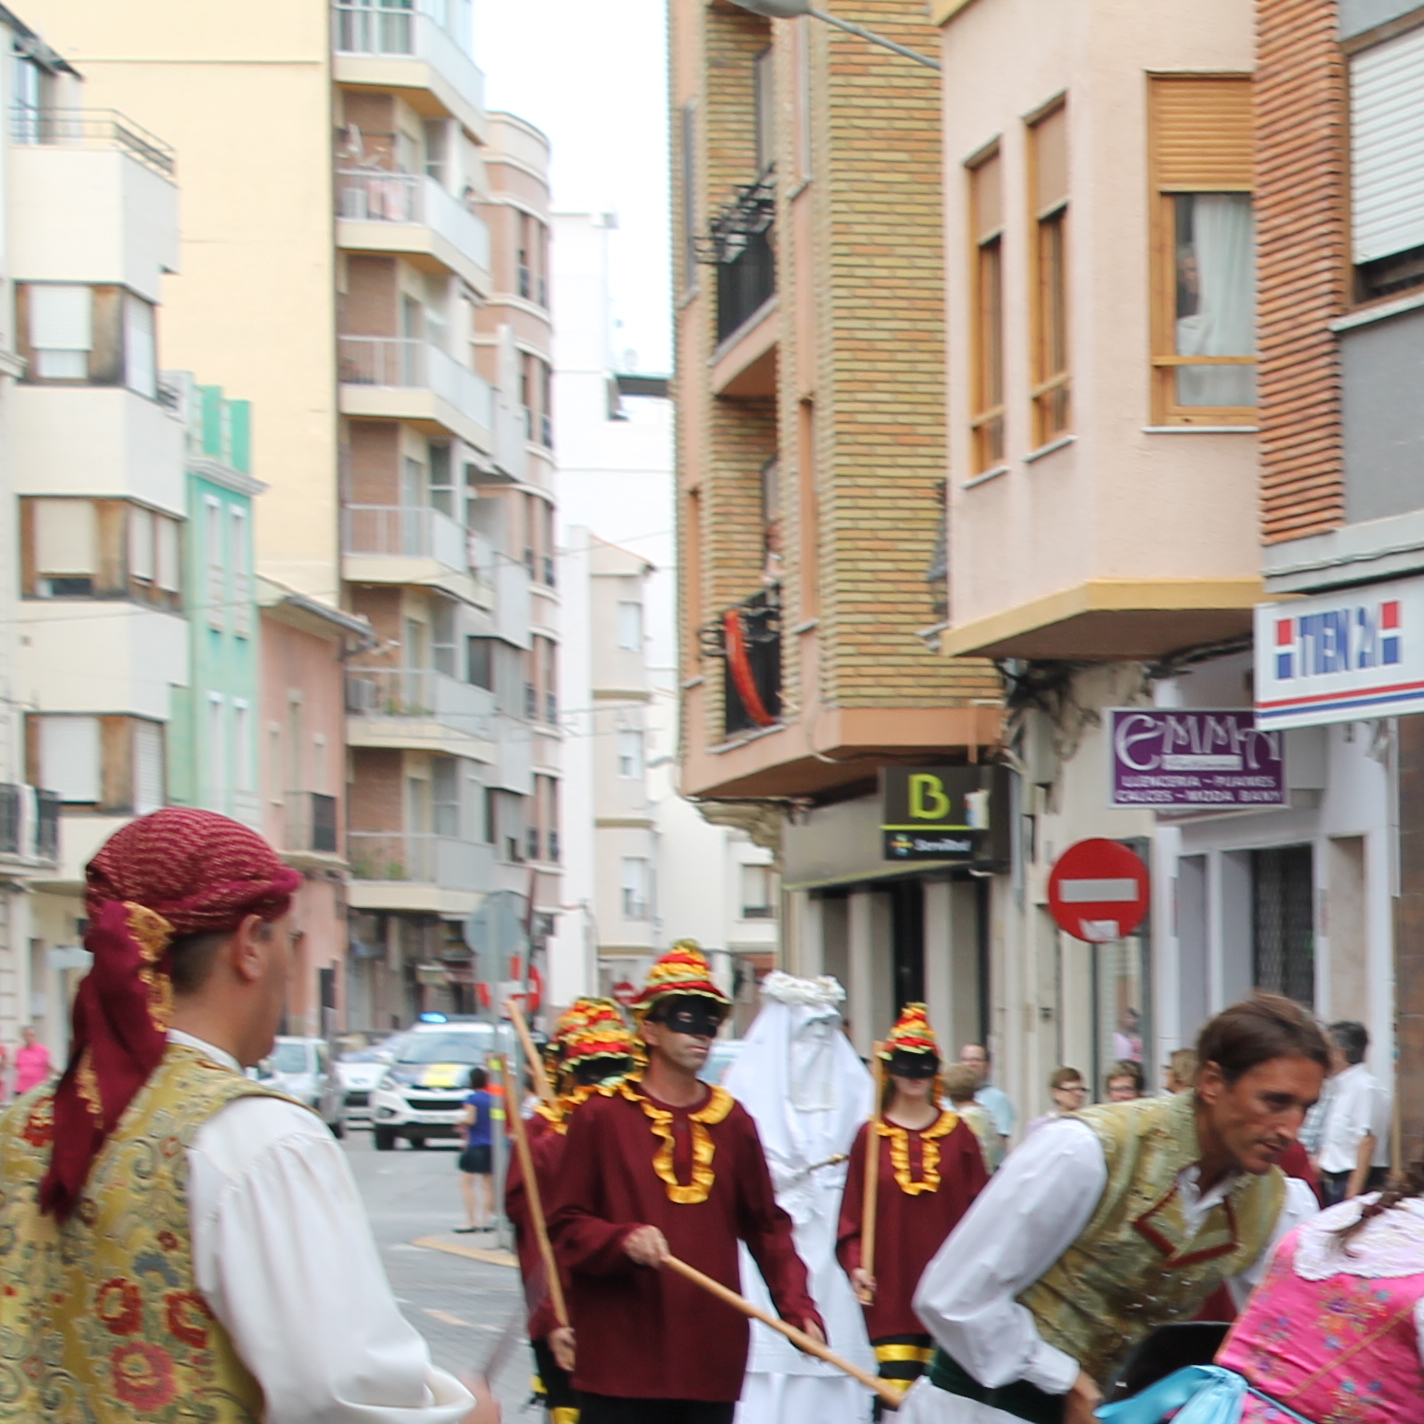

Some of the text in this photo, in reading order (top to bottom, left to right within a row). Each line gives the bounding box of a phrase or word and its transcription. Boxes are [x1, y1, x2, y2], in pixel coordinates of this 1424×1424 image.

[1297, 606, 1379, 677] TIEN 21
[908, 773, 951, 819] B
